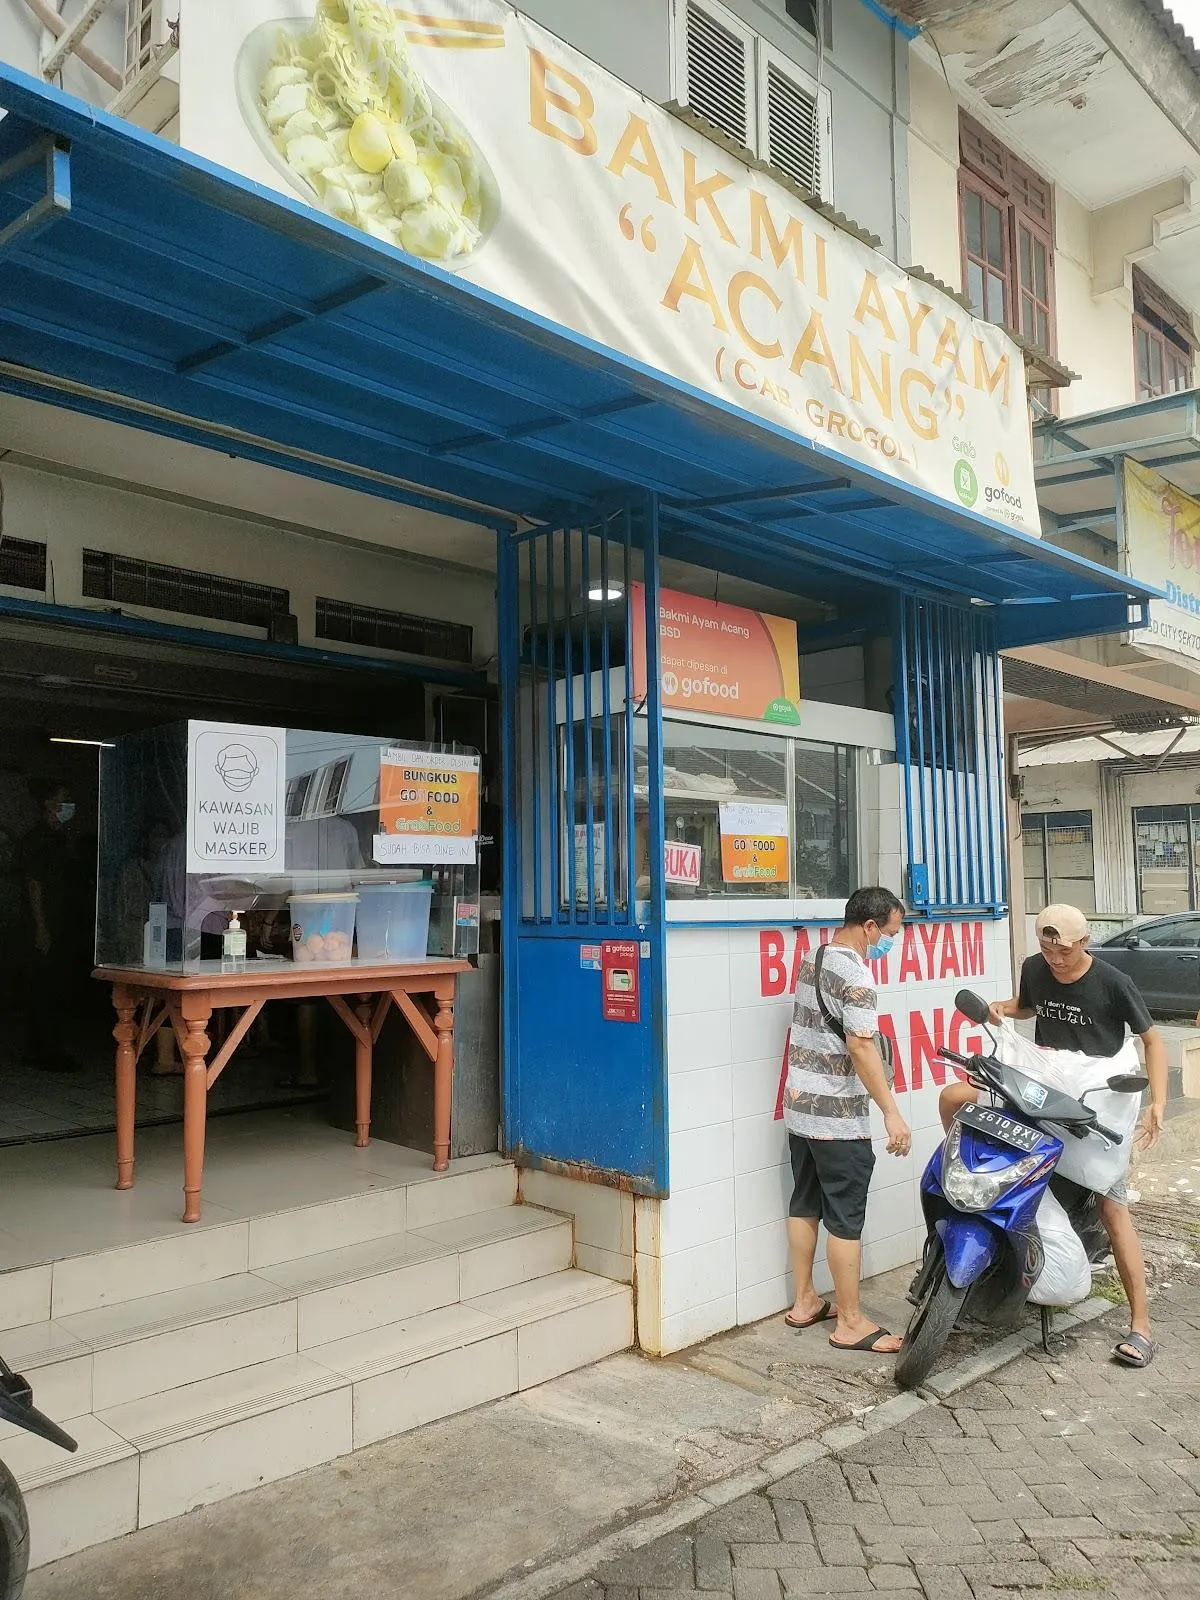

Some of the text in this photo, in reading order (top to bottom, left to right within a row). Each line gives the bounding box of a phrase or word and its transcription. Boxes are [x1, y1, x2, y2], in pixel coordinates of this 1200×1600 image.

[527, 46, 1011, 407] BAKMI AYAM
[984, 486, 1023, 510] gofood
[659, 607, 750, 640] Bakmi Ayam Acang
[659, 624, 681, 639] BSD
[1160, 622, 1177, 641] CITY
[686, 659, 719, 673] dipesan
[720, 664, 728, 675] di
[681, 676, 739, 699] gofood
[403, 770, 458, 784] BUNGKUS
[427, 791, 460, 804] FOOD
[199, 800, 274, 816] KAWASAN
[426, 805, 433, 816] &
[213, 822, 260, 835] WAJIB
[396, 818, 461, 832] GrabFood
[205, 842, 267, 855] MASKER
[752, 840, 776, 851] FOOD
[752, 854, 758, 863] &
[899, 921, 985, 983] AYAM
[1035, 1004, 1093, 1026] 気にしない
[1066, 1005, 1082, 1013] care
[965, 1104, 976, 1114] B
[1011, 1124, 1041, 1143] BXV
